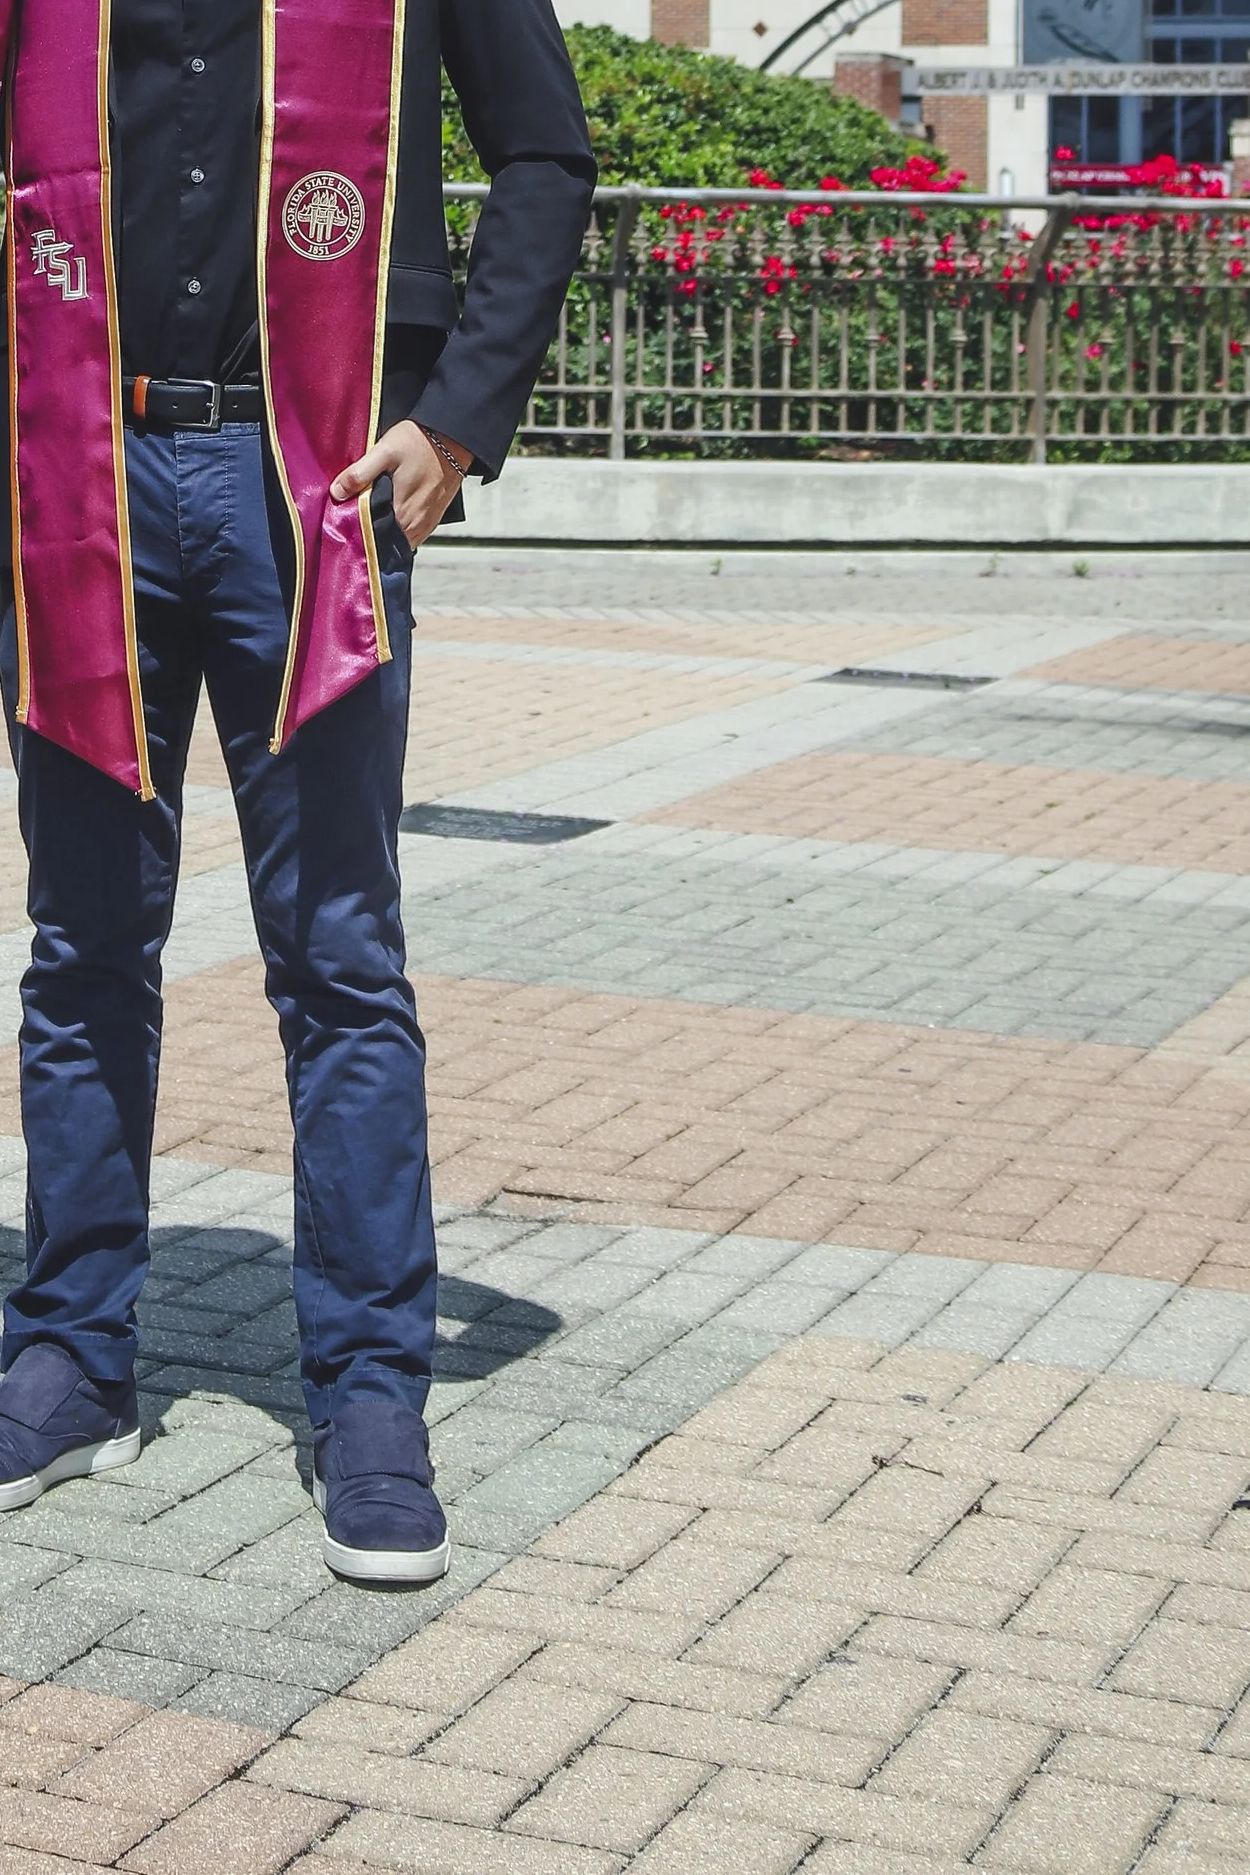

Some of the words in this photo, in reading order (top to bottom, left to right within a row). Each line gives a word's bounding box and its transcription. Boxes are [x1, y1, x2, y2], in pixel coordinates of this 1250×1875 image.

[917, 71, 967, 90] ALBERT
[1002, 70, 1048, 89] JUDITH
[1069, 70, 1126, 89] DUNLAP
[1131, 70, 1211, 88] CHAMPIONS
[287, 189, 305, 236] FLORIDA
[305, 177, 335, 190] STATE
[337, 182, 360, 243] UNIVERSITY
[31, 230, 89, 301] FSU
[308, 245, 330, 255] 1851
